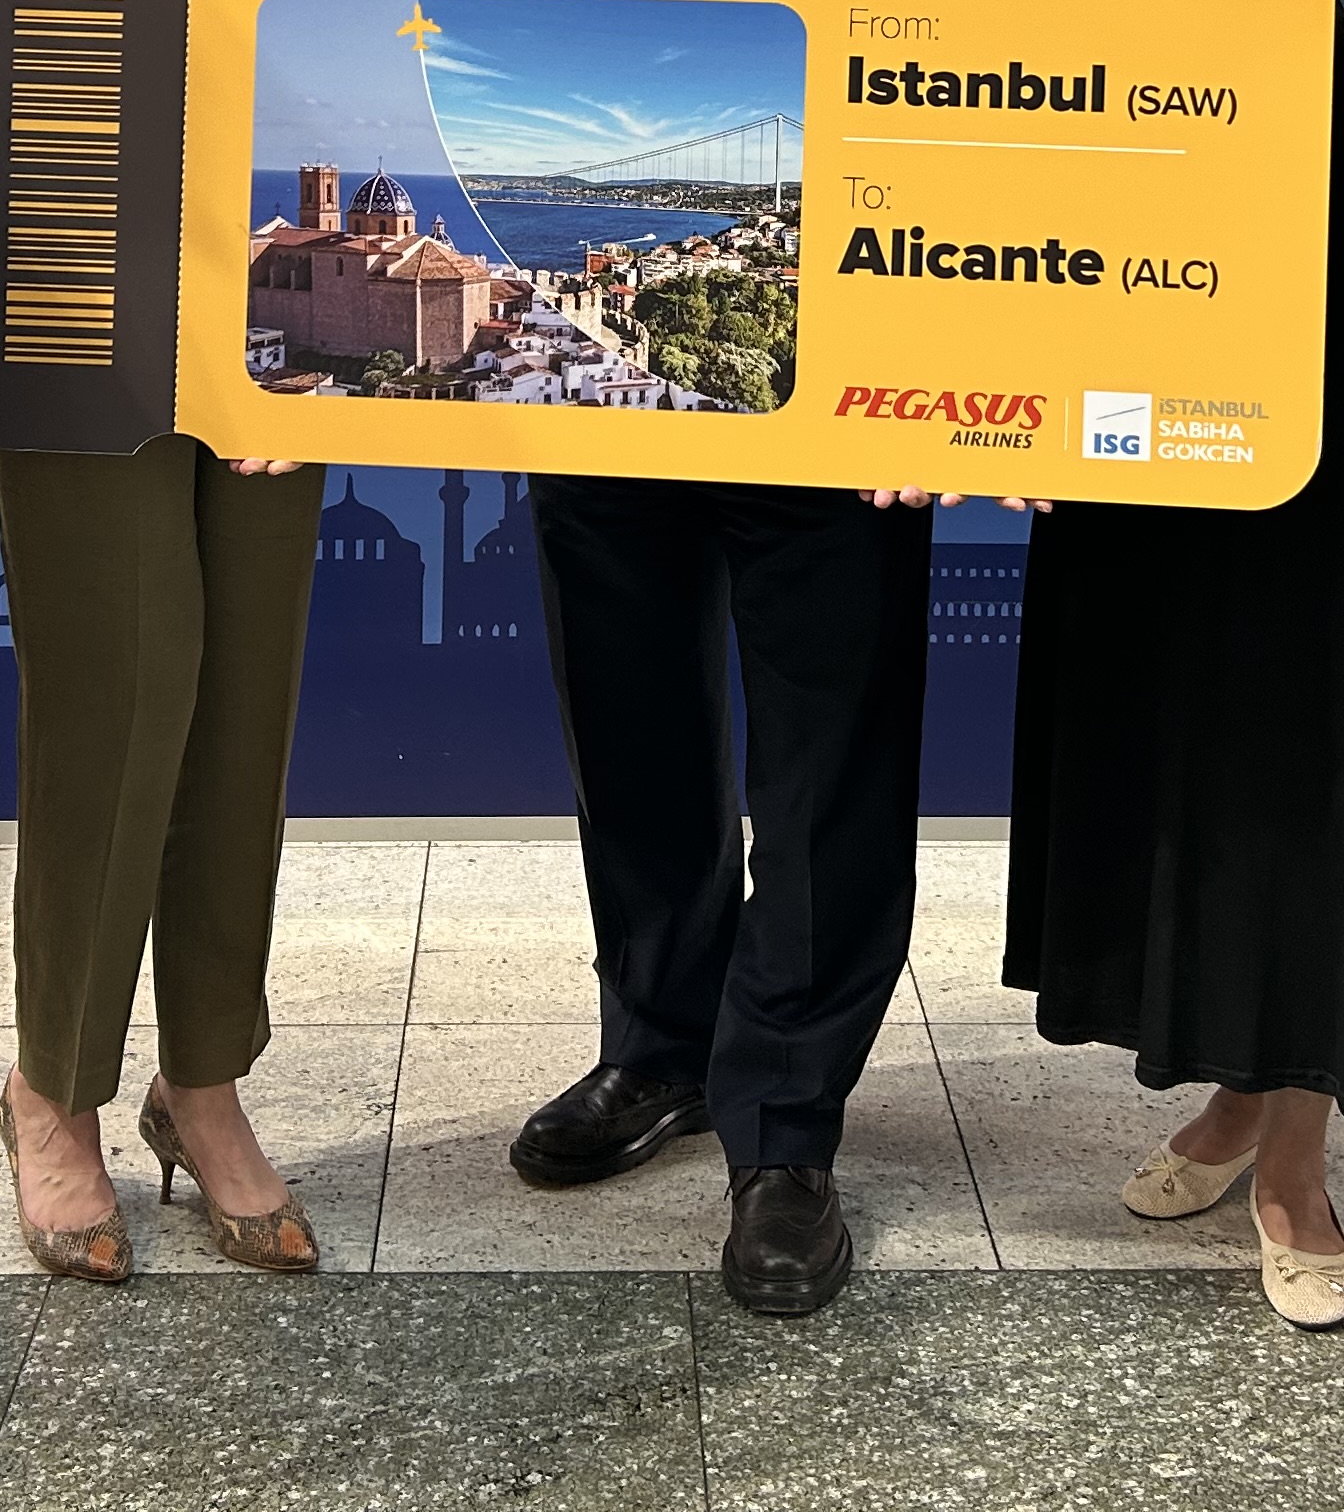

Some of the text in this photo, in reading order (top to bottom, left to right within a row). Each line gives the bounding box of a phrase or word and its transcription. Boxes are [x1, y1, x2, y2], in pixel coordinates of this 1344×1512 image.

[850, 8, 939, 40] From:
[848, 56, 1237, 125] Istanbul (SAW)
[843, 177, 891, 209] To:
[838, 226, 1218, 298] Alicante (ALC)
[835, 387, 1047, 429] PEGASUS
[949, 430, 1033, 449] AIRLINES
[1094, 434, 1139, 454] ISG
